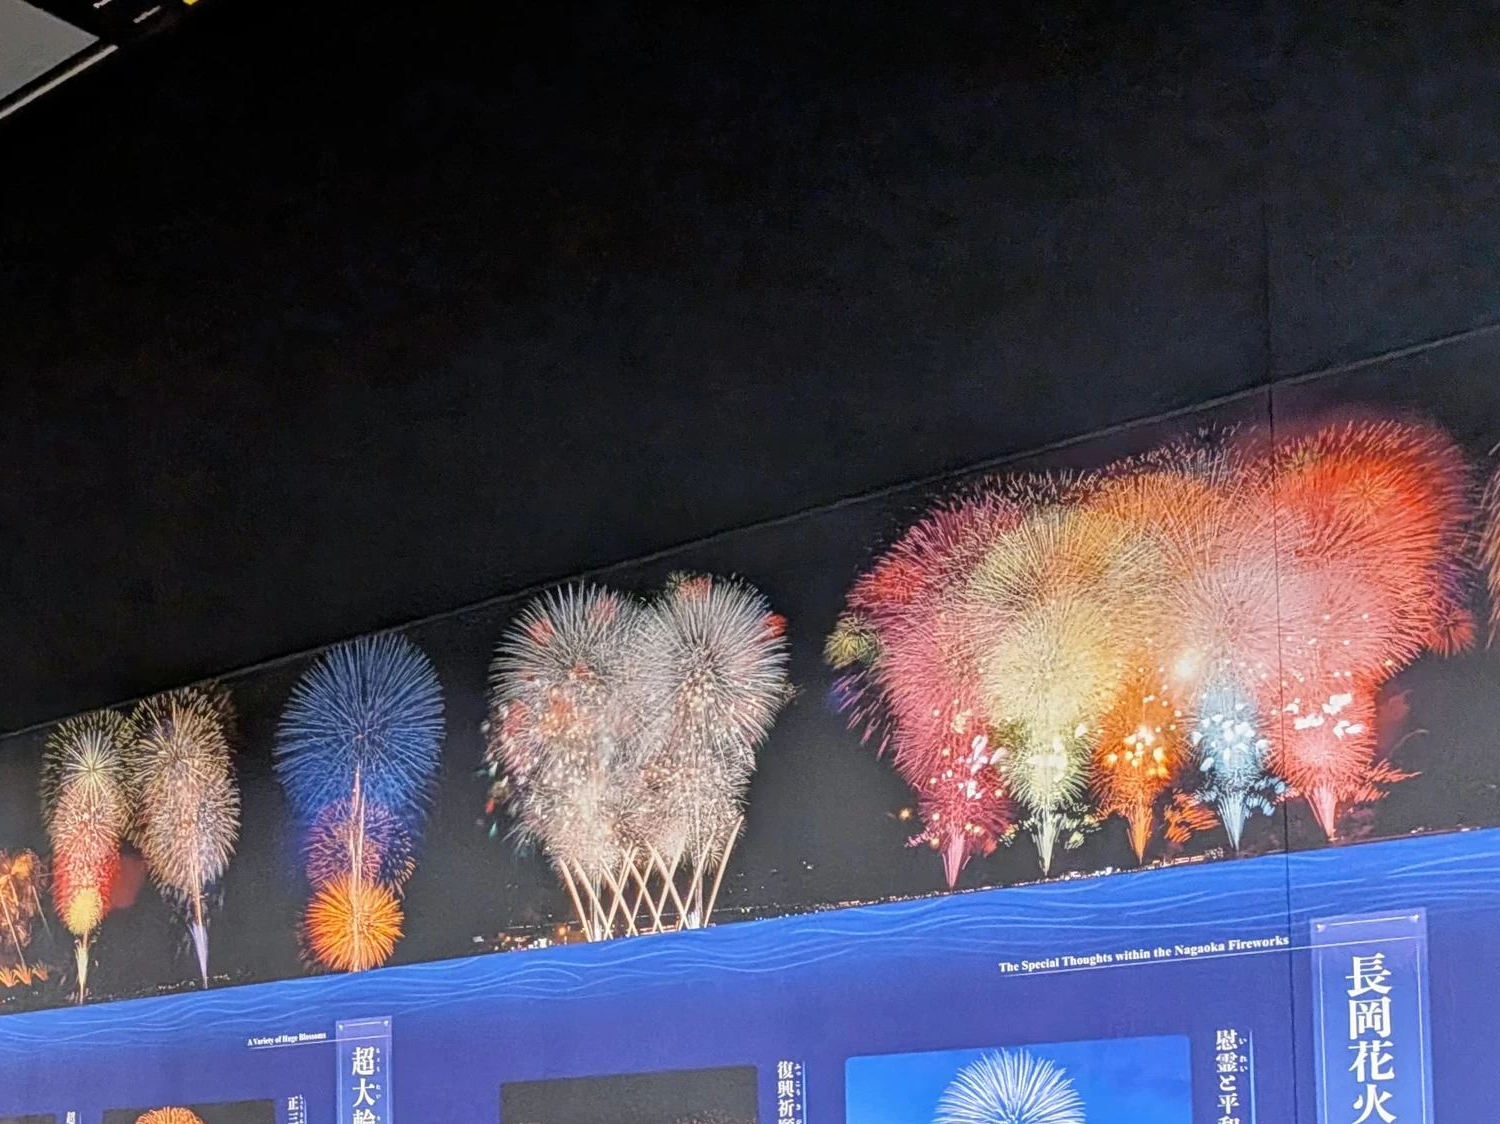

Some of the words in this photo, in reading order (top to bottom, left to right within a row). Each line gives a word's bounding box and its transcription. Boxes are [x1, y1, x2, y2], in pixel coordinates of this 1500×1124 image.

[999, 961, 1020, 973] The
[1022, 958, 1060, 973] Special
[1062, 953, 1113, 968] Thoughts
[1115, 949, 1151, 962] within
[1153, 947, 1172, 958] the
[1174, 941, 1226, 957] Nagaoka
[1228, 935, 1290, 951] Fireworks
